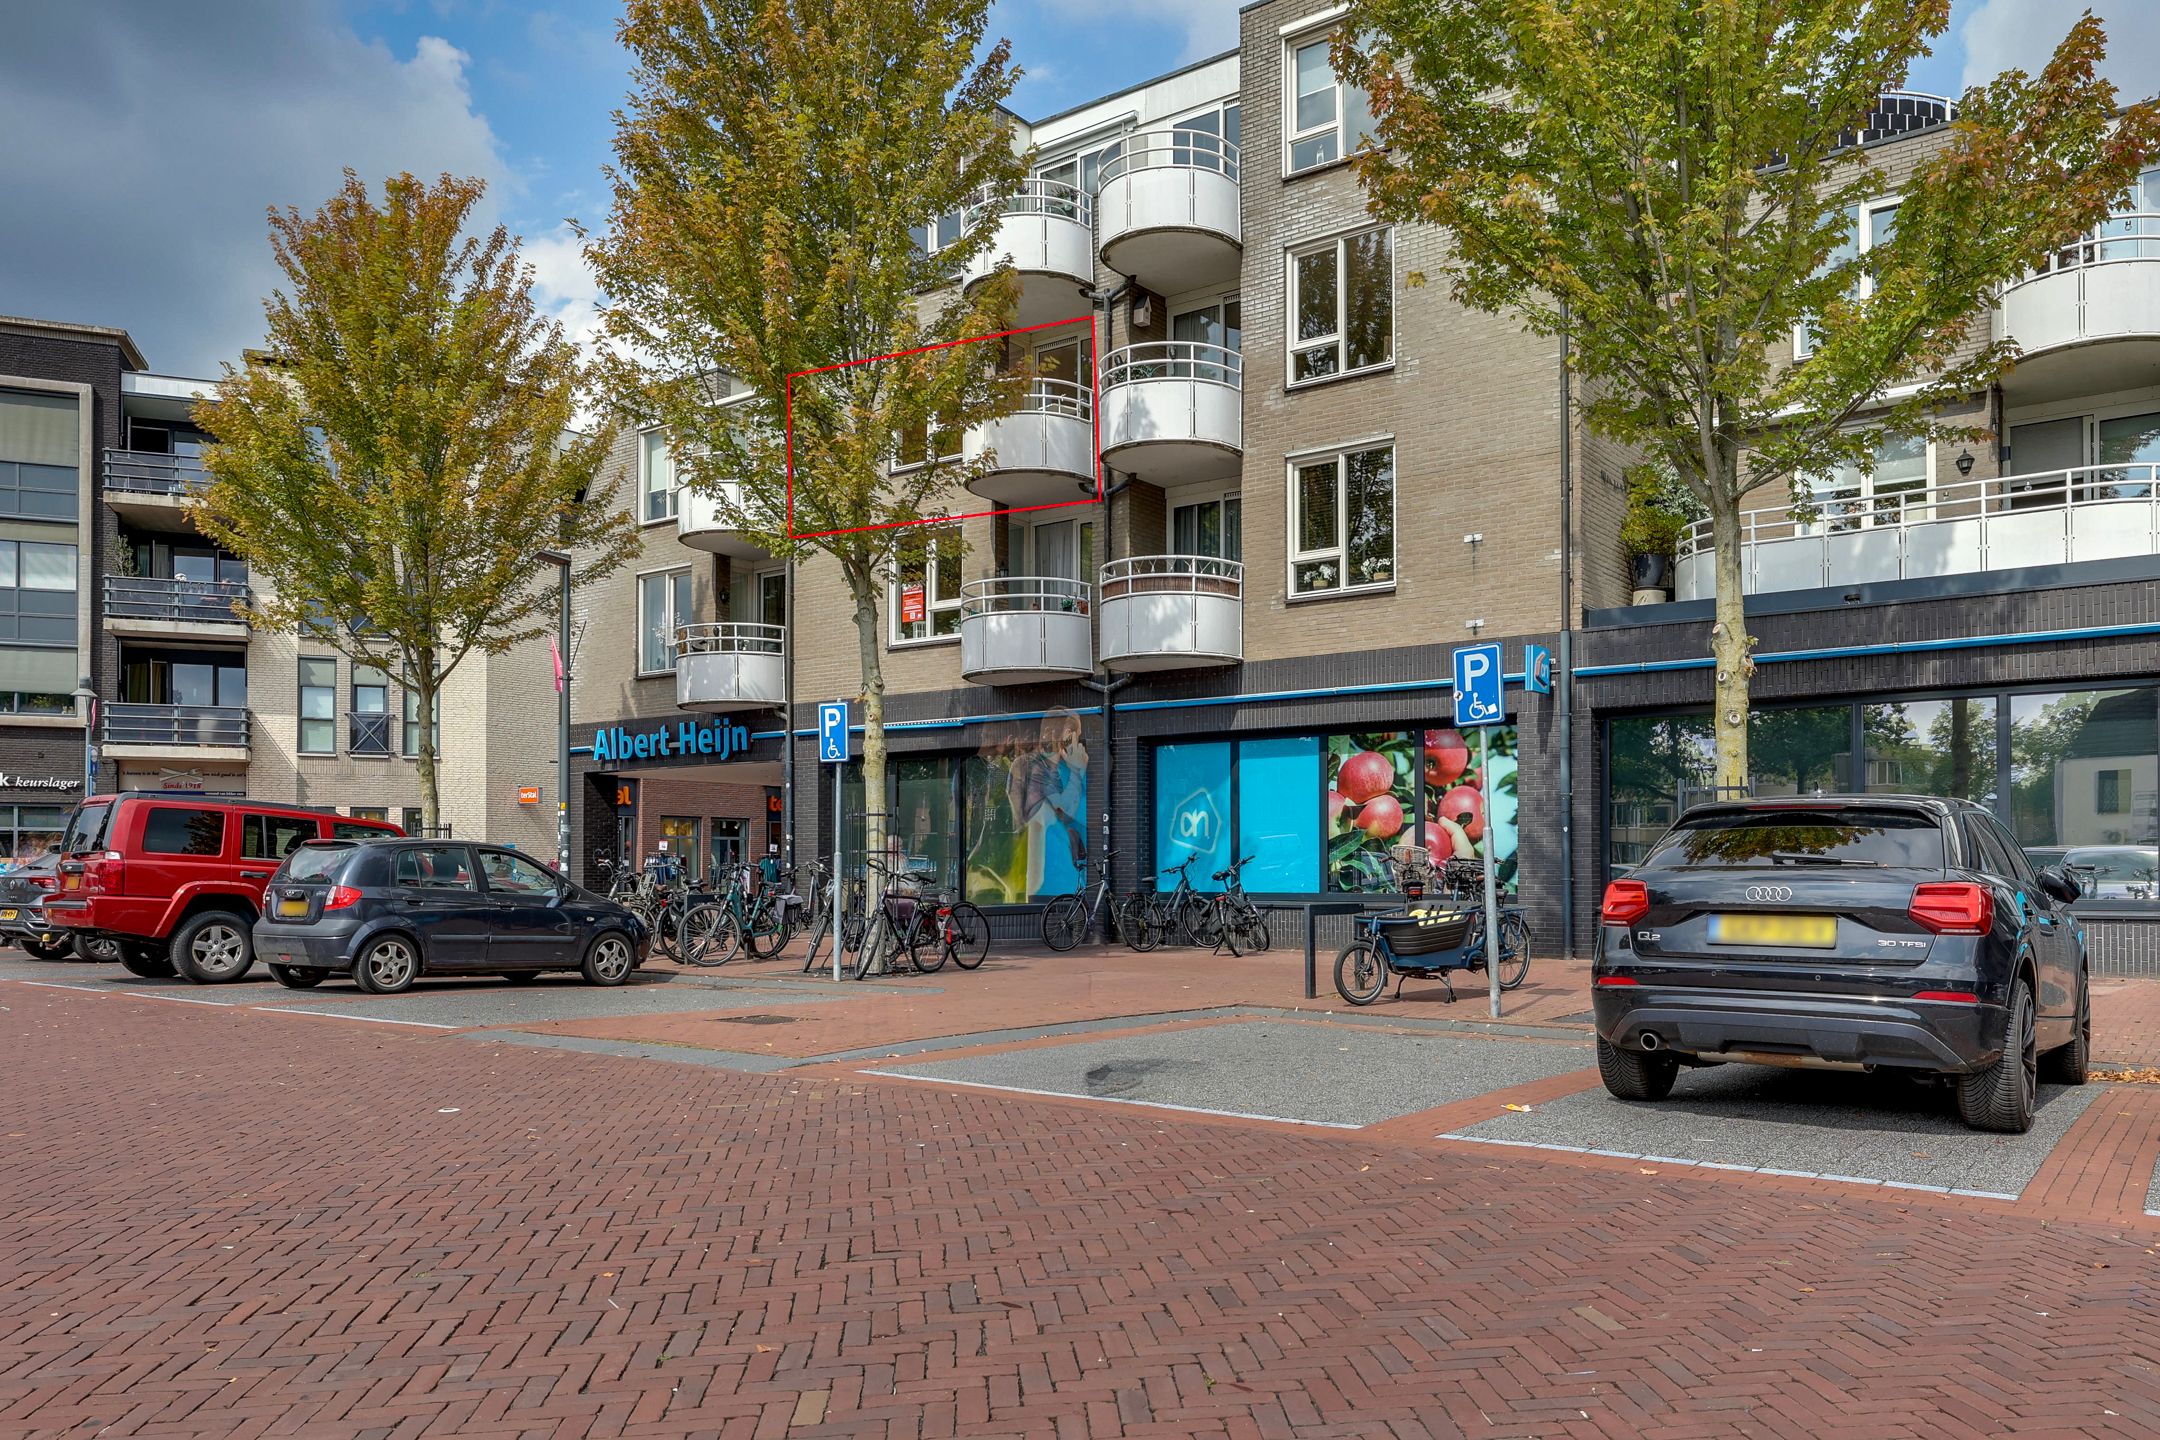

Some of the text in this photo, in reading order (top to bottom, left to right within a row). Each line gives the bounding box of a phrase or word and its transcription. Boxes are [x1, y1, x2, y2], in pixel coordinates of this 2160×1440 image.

[1464, 653, 1490, 692] P
[825, 708, 841, 738] P
[593, 718, 747, 760] Albert Heijn
[15, 776, 81, 790] keurslager
[1637, 931, 1661, 941] Q2
[1877, 939, 1927, 948] 30 TFSI
